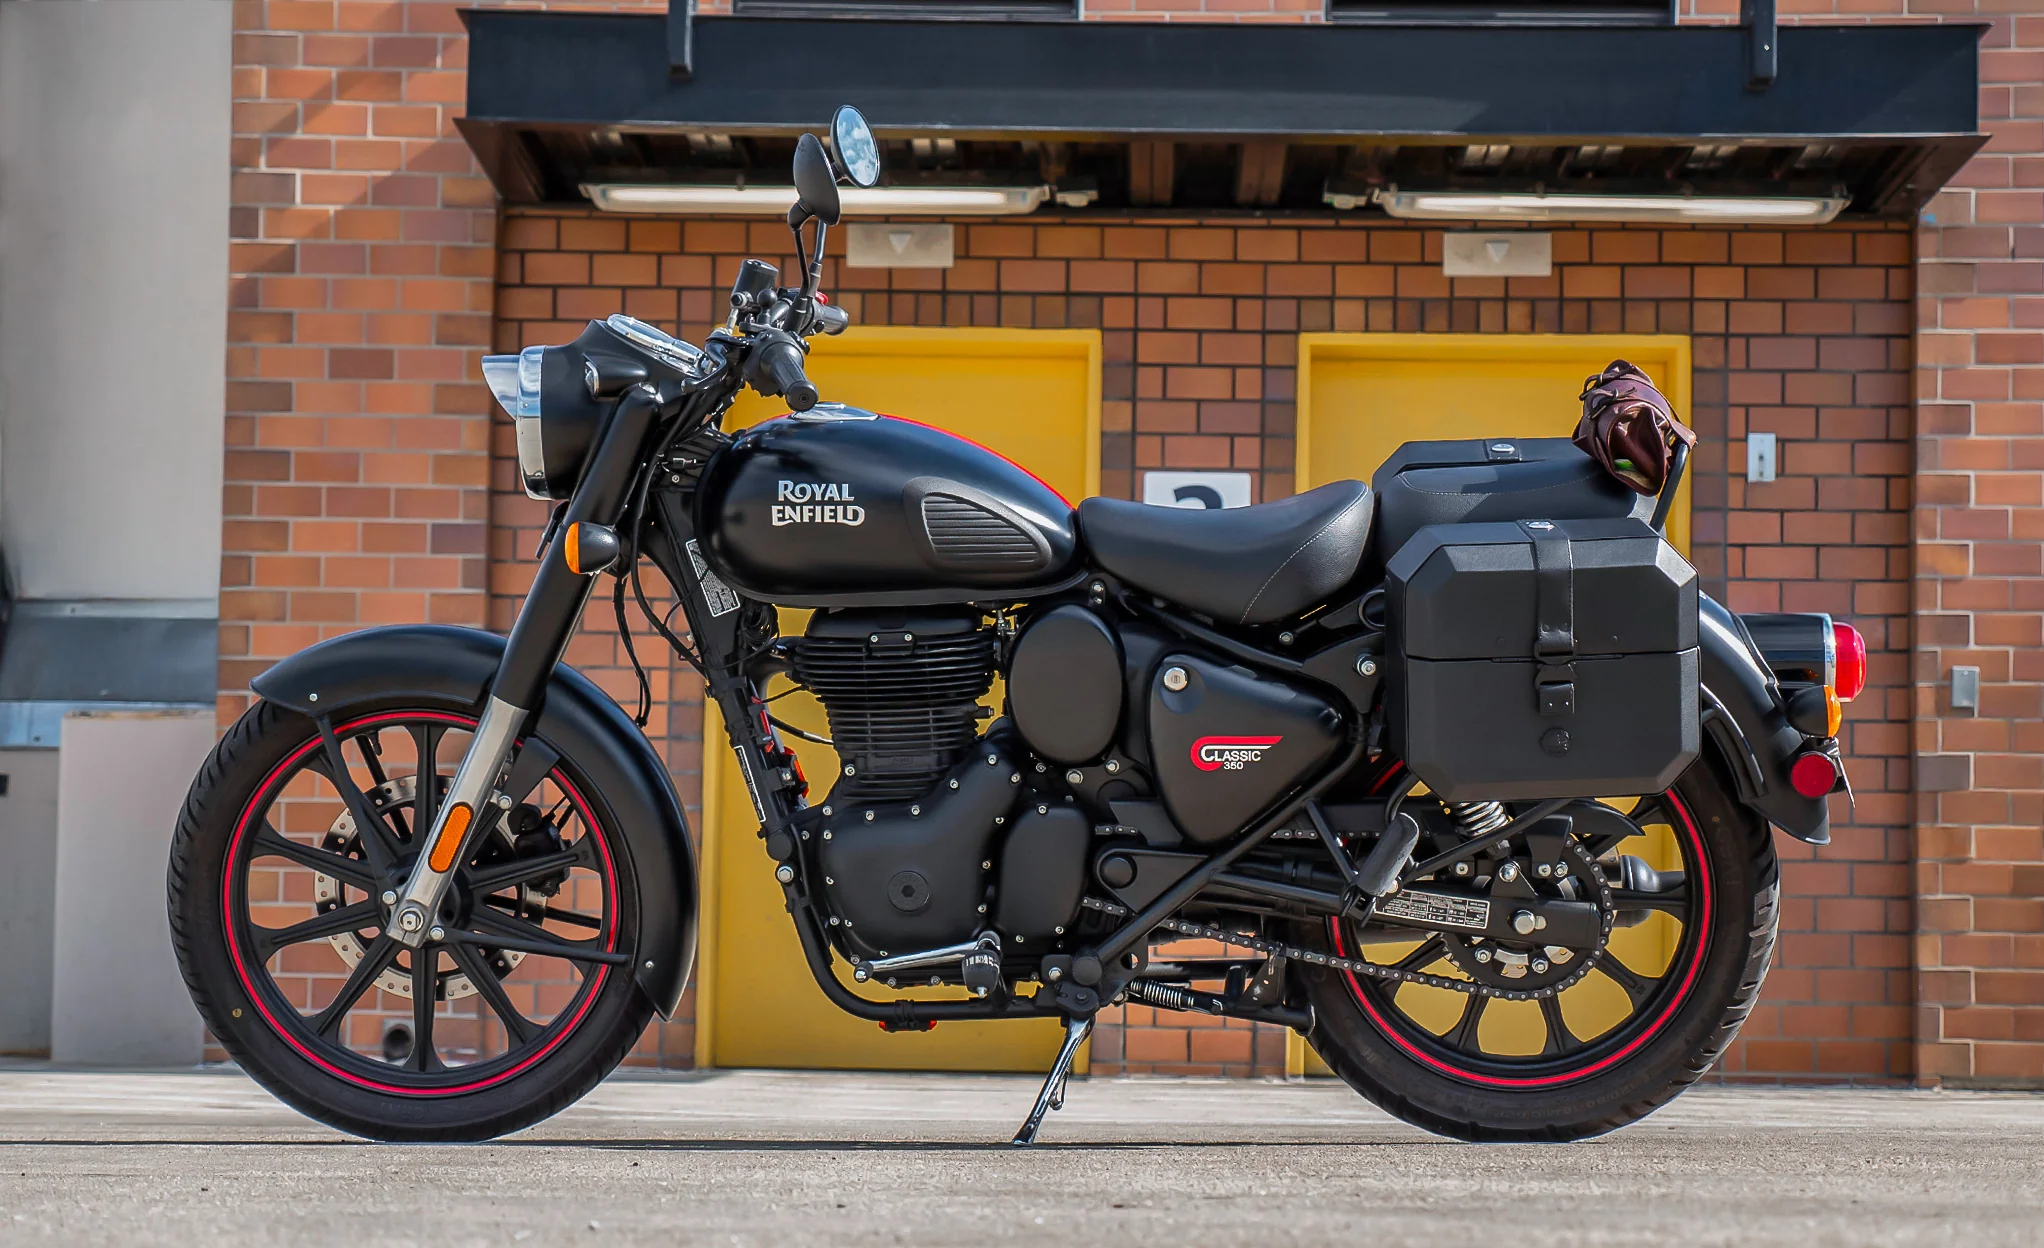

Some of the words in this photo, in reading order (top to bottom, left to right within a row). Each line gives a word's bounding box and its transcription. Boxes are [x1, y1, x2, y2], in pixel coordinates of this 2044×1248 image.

[778, 480, 855, 503] ROYAL
[771, 505, 865, 526] ENFIELD
[1200, 745, 1262, 762] CLASSIC
[1223, 761, 1244, 770] 350
